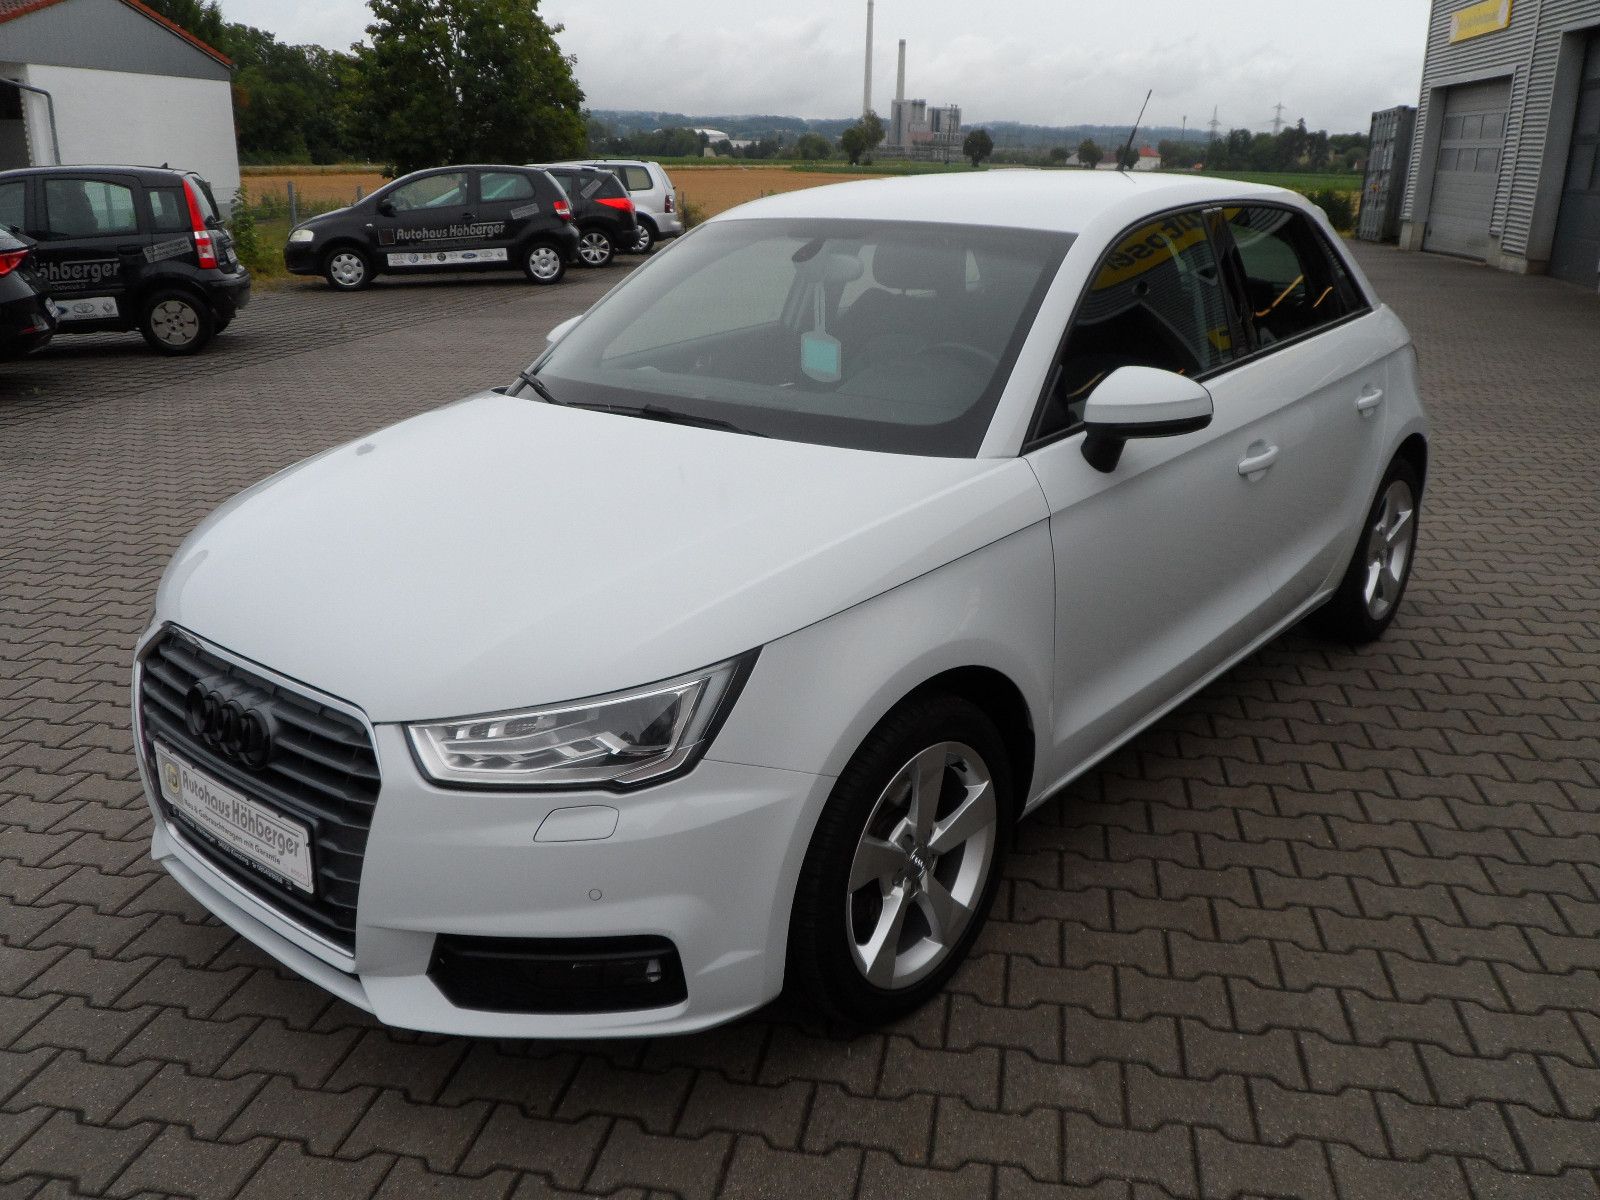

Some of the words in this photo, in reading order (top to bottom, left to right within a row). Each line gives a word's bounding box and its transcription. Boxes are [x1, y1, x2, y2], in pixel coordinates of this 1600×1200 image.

[396, 227, 448, 240] Autohaus
[449, 222, 505, 238] Höhberger
[182, 771, 231, 817] Autohaus
[232, 801, 299, 857] Höhberger
